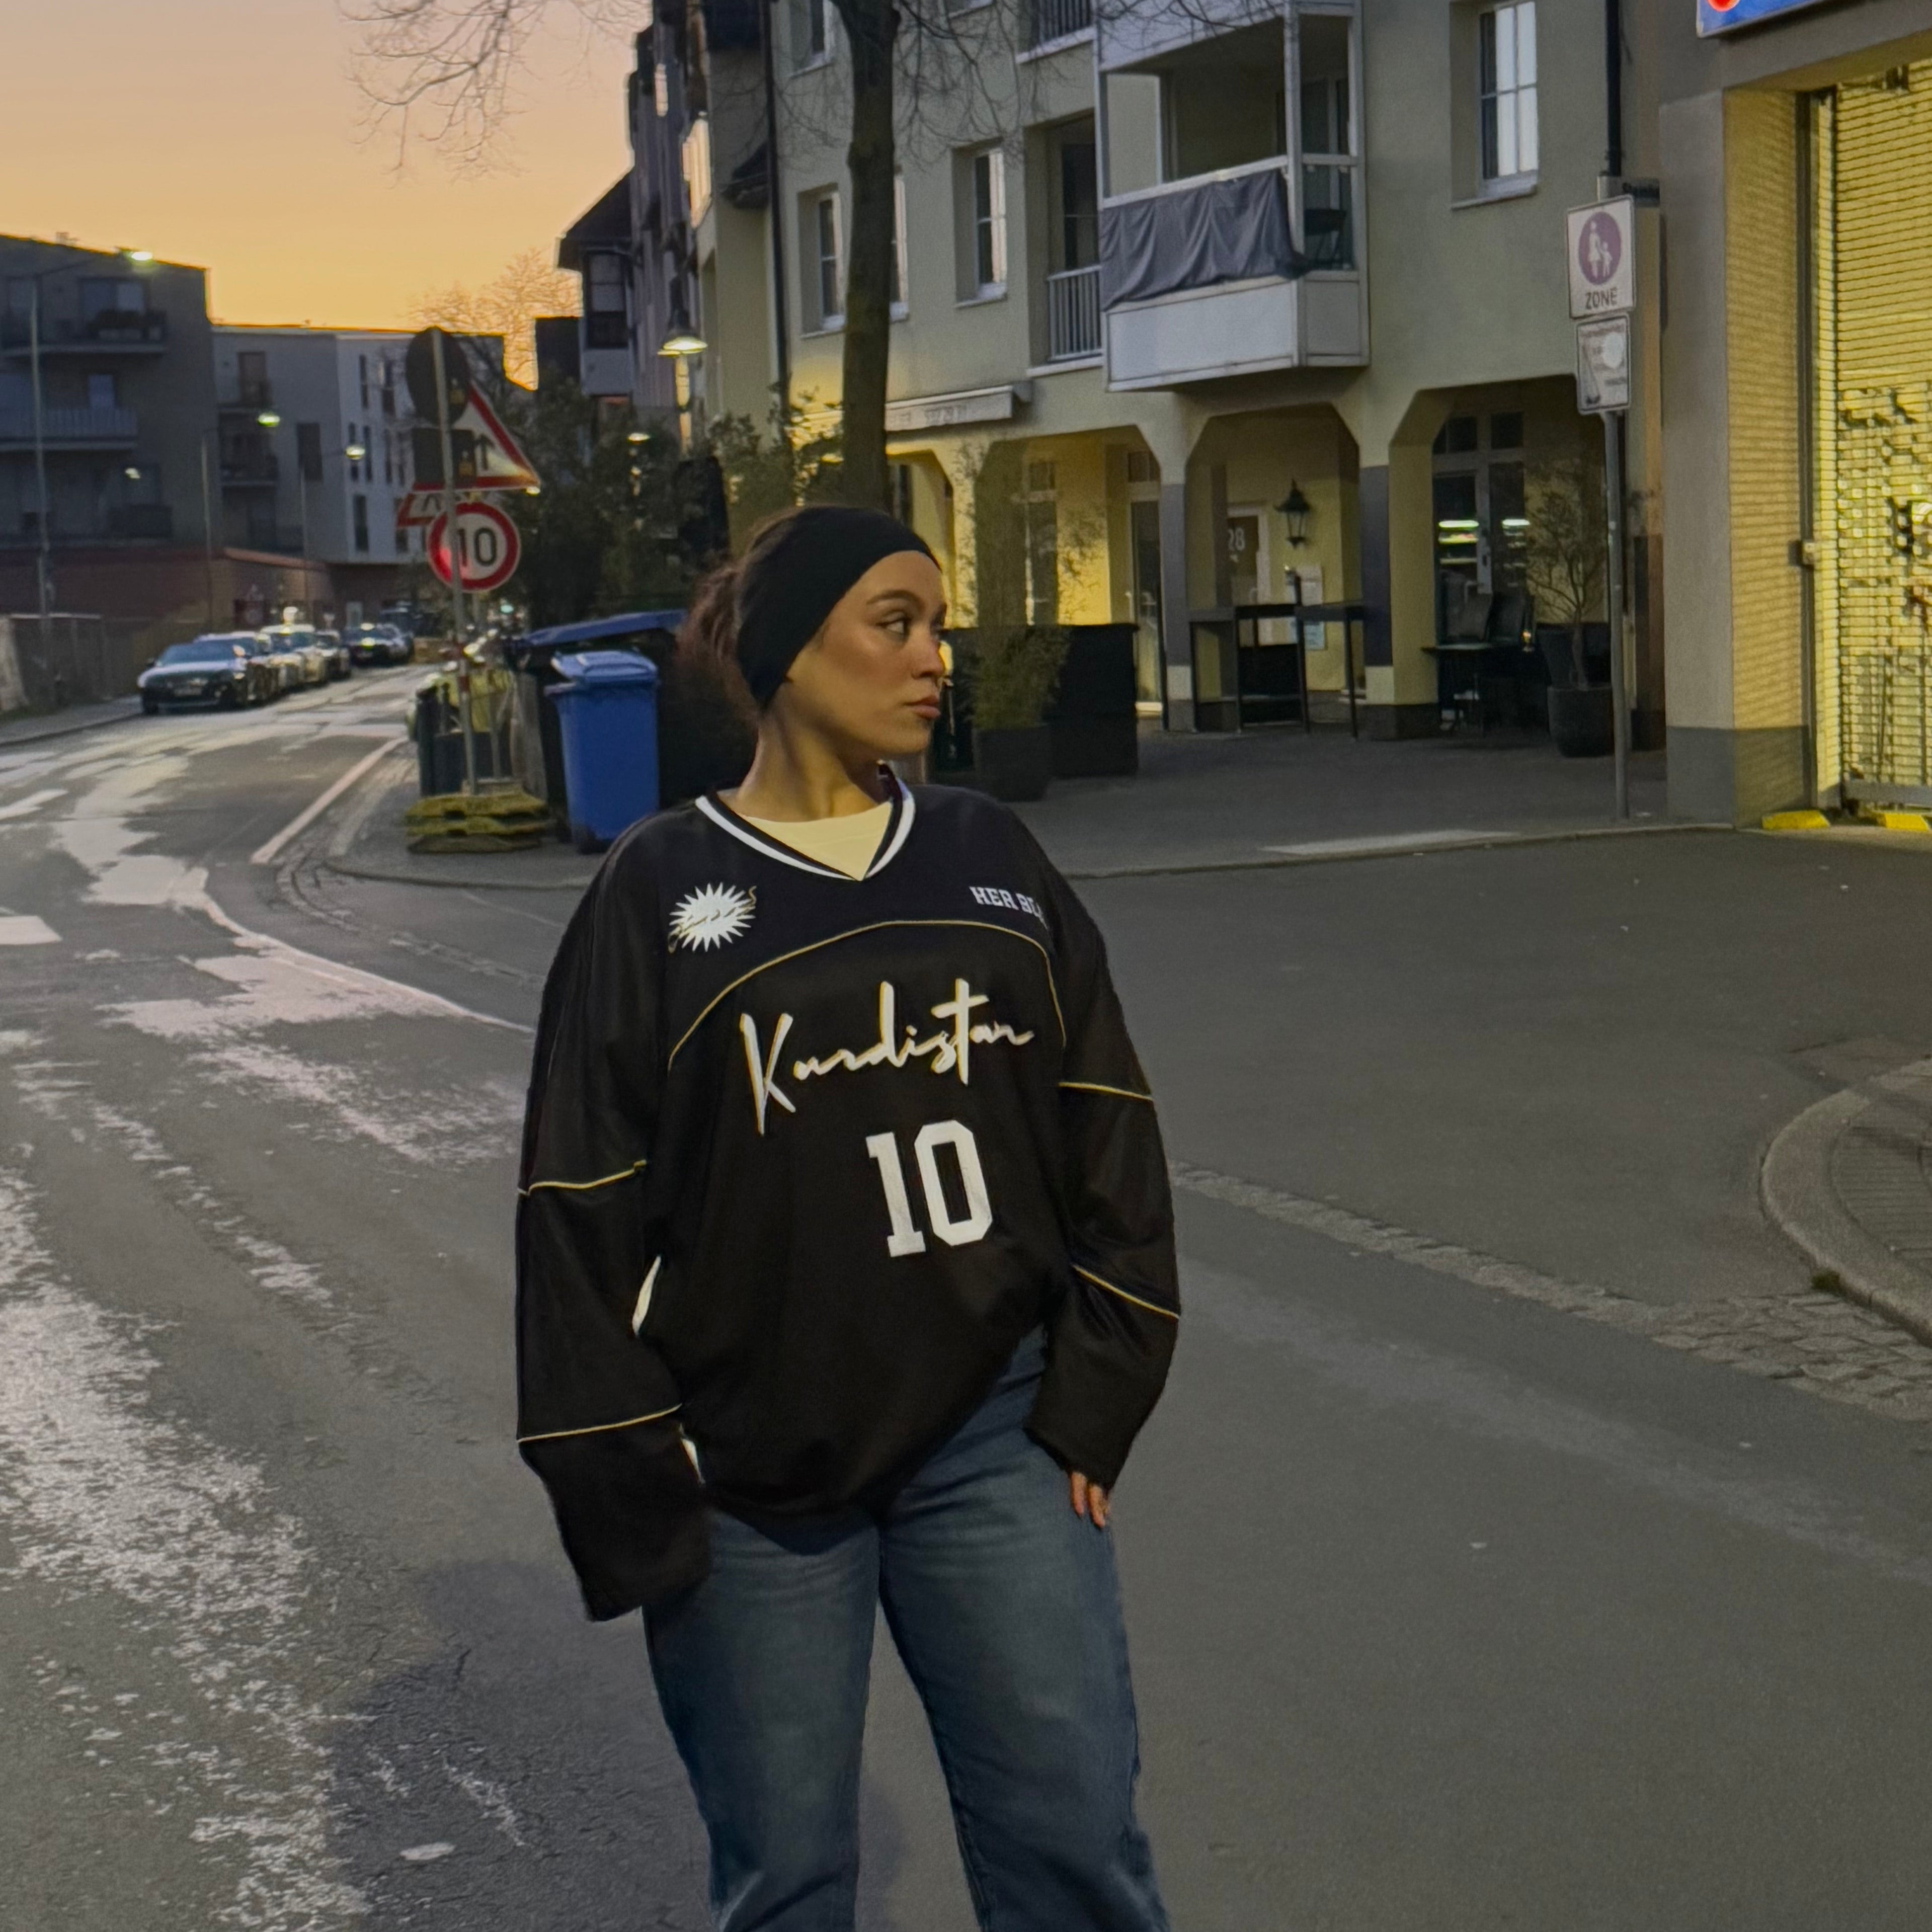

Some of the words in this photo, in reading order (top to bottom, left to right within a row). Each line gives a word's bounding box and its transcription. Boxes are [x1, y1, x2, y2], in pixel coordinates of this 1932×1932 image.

[1585, 288, 1618, 309] ZONE
[457, 527, 497, 567] 10
[1228, 527, 1245, 551] 28
[969, 886, 1019, 911] HER
[739, 978, 1034, 1135] Kurdistan
[865, 1119, 993, 1257] 10
